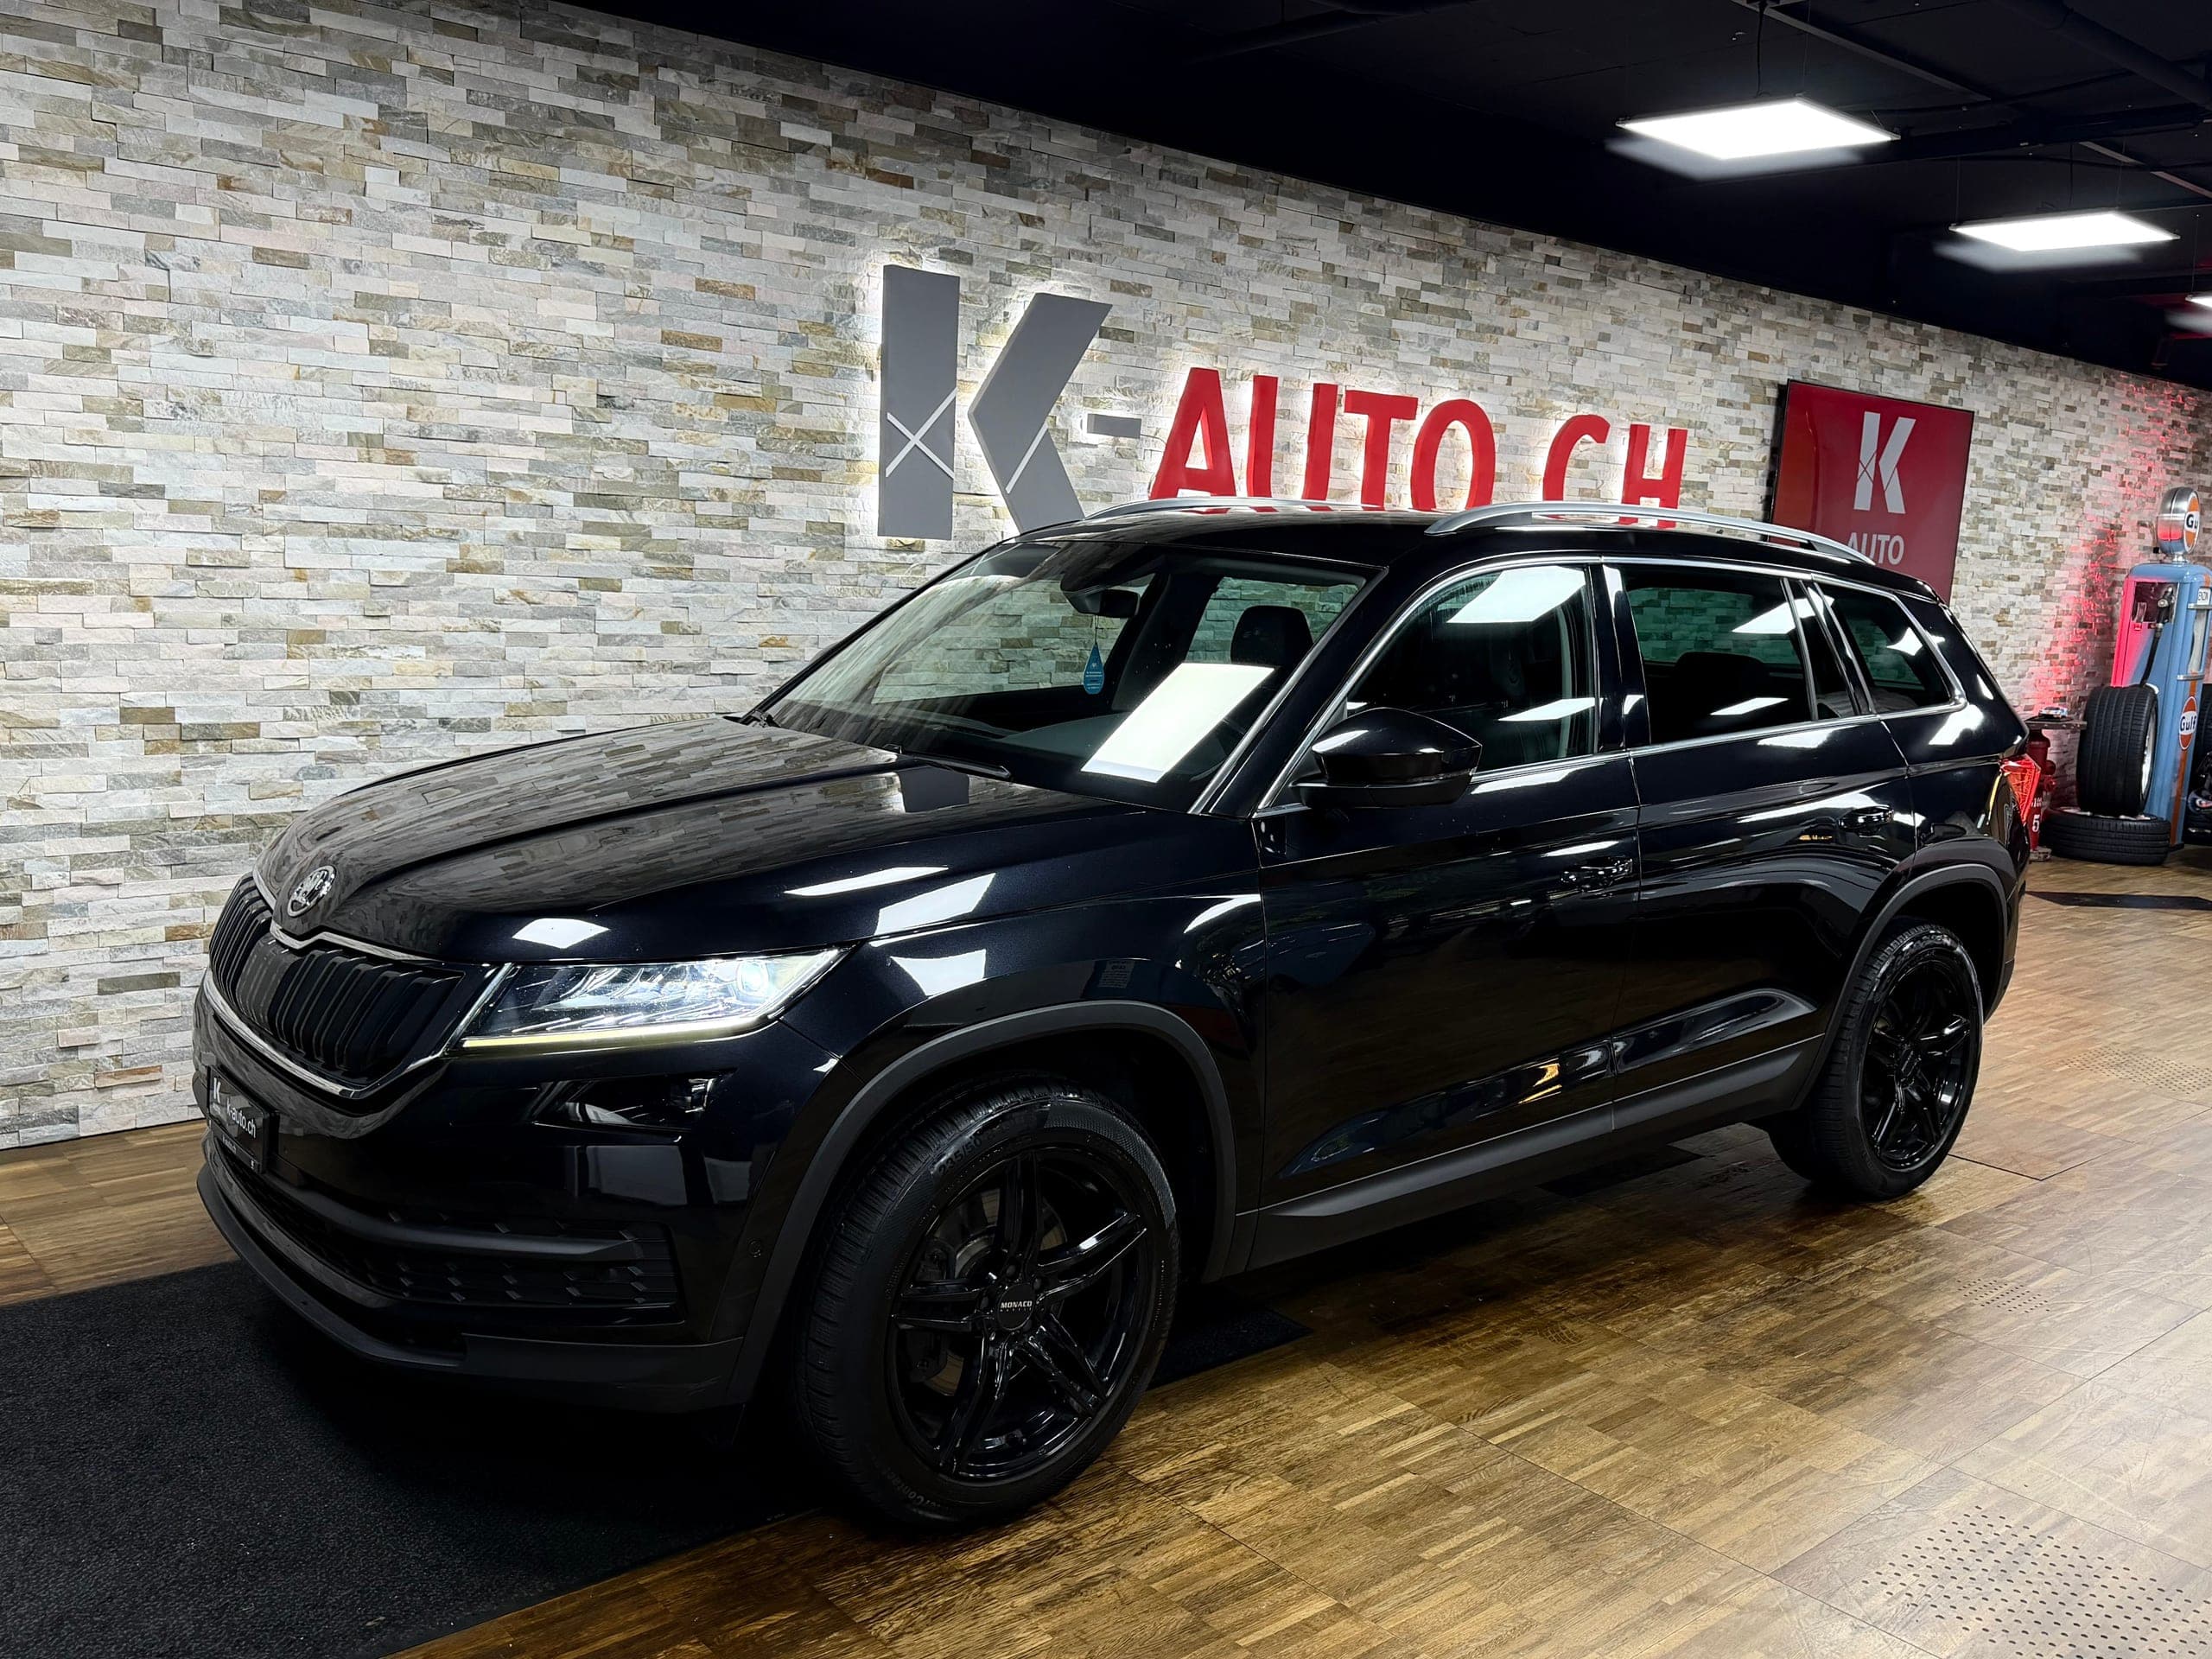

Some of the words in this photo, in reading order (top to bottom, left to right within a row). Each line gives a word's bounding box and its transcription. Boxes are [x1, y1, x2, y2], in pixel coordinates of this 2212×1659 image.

[1853, 411, 1916, 514] K
[1847, 532, 1904, 565] AUTO
[2180, 715, 2196, 731] Gulf
[2031, 814, 2040, 832] 5
[226, 1096, 257, 1139] k-auto.ch
[1000, 1300, 1033, 1309] MONACO
